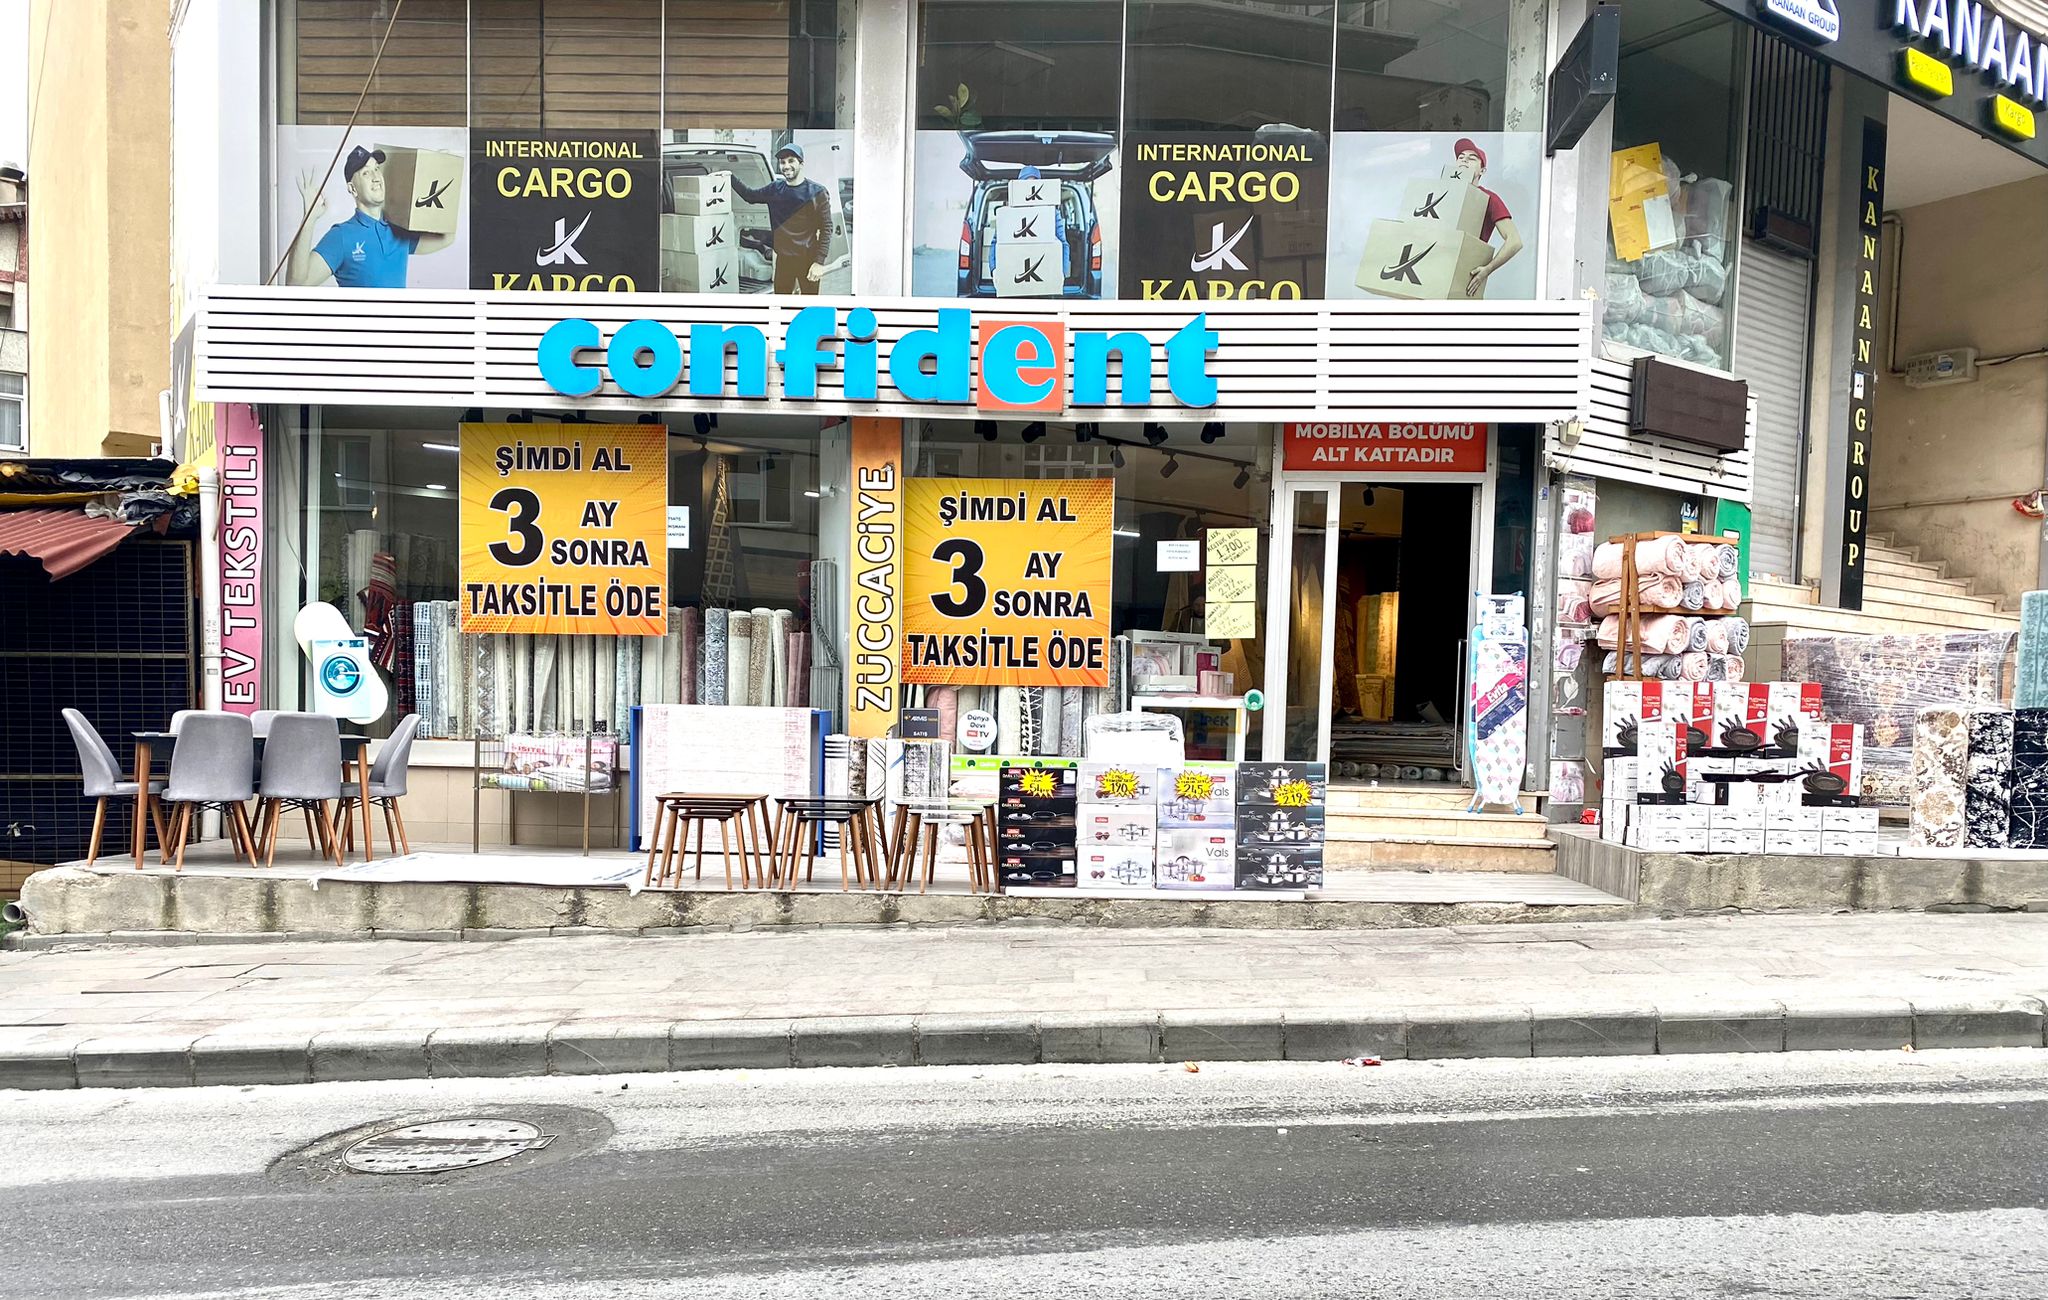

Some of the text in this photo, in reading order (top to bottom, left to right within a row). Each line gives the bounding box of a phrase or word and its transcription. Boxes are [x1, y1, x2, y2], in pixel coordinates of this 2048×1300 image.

[1808, 12, 1837, 33] GROUP
[486, 140, 644, 159] INTERNATIONAL
[1137, 143, 1313, 162] INTERNATIONAL
[497, 166, 633, 199] CARGO
[1148, 170, 1301, 203] CARGO
[1856, 165, 1881, 364] KANAAN
[538, 306, 1219, 408] confident
[495, 440, 632, 476] ŞİMDİ AL
[1312, 447, 1455, 463] ALT KATTADIR
[1847, 407, 1867, 567] GROUP
[938, 490, 1077, 527] ŞİMDİ AL
[488, 487, 618, 567] 3 AY
[551, 538, 650, 568] SONRA
[930, 538, 1064, 620] 3 AY
[467, 576, 662, 618] TAKSİTLE ÖDE
[993, 589, 1094, 619] SONRA
[907, 628, 1104, 670] TAKSİTLE ÖDE
[223, 648, 257, 706] EV
[1184, 784, 1204, 794] 245
[1206, 847, 1229, 858] Vals
